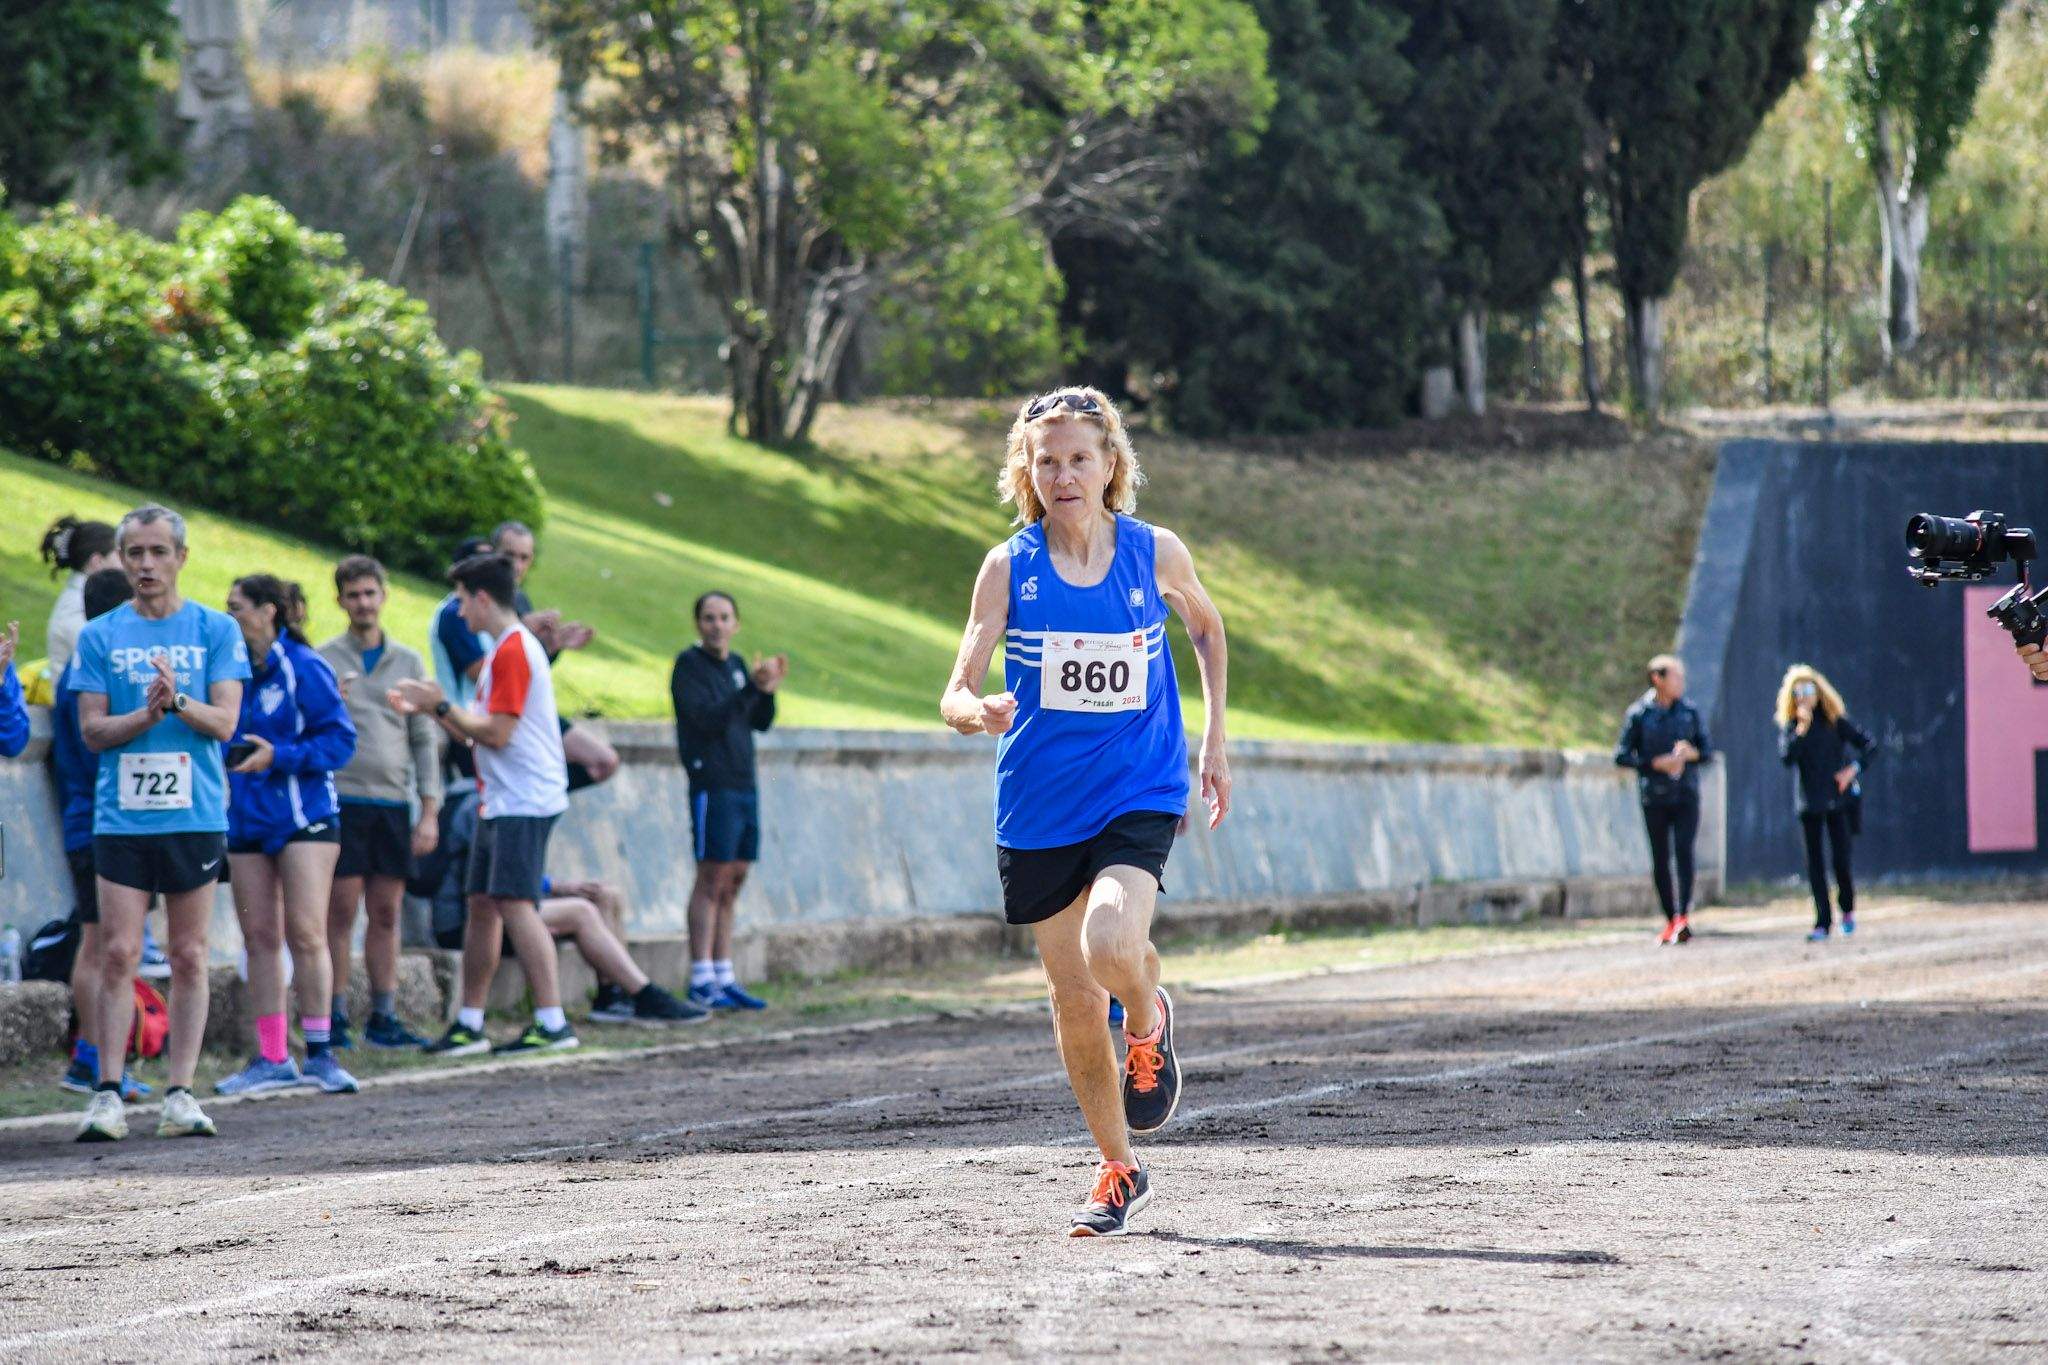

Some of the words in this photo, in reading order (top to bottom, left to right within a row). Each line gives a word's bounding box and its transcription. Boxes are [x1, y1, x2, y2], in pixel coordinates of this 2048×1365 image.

[110, 645, 207, 673] SPORT
[1060, 660, 1130, 694] 860
[1122, 696, 1141, 705] 2023
[132, 772, 178, 796] 722
